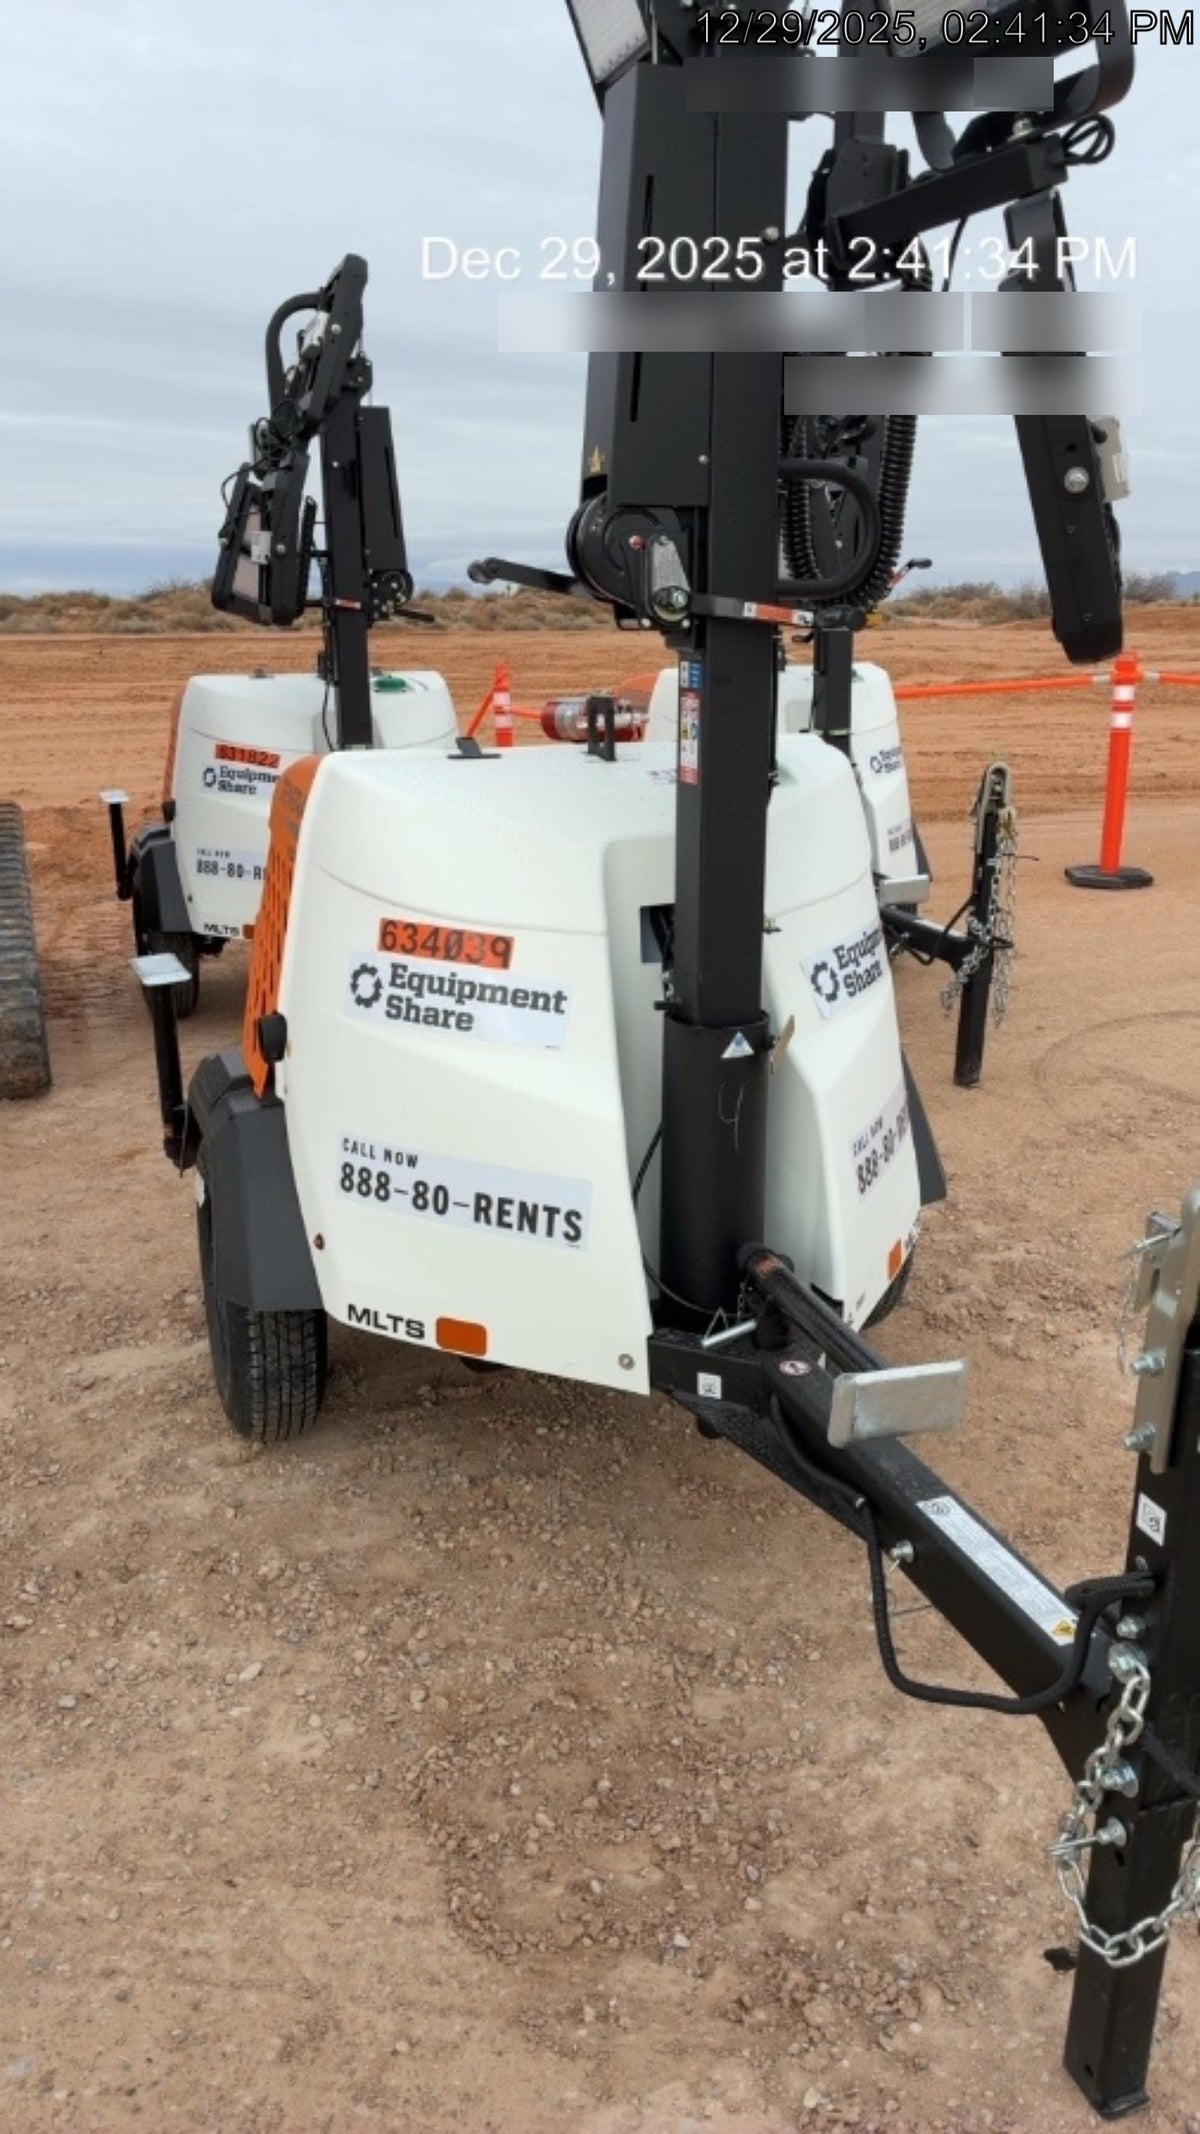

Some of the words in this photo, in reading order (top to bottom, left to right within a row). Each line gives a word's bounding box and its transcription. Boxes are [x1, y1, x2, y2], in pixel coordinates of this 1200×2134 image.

[218, 780, 257, 796] Share
[220, 765, 281, 784] Equipme
[380, 919, 513, 969] 634039
[388, 962, 568, 1015] Equipment
[385, 994, 475, 1032] Share
[342, 1137, 377, 1160] CALL
[383, 1147, 419, 1169] NOW
[340, 1161, 584, 1243] 888-80-RENTS
[347, 1303, 426, 1340] MLTS
